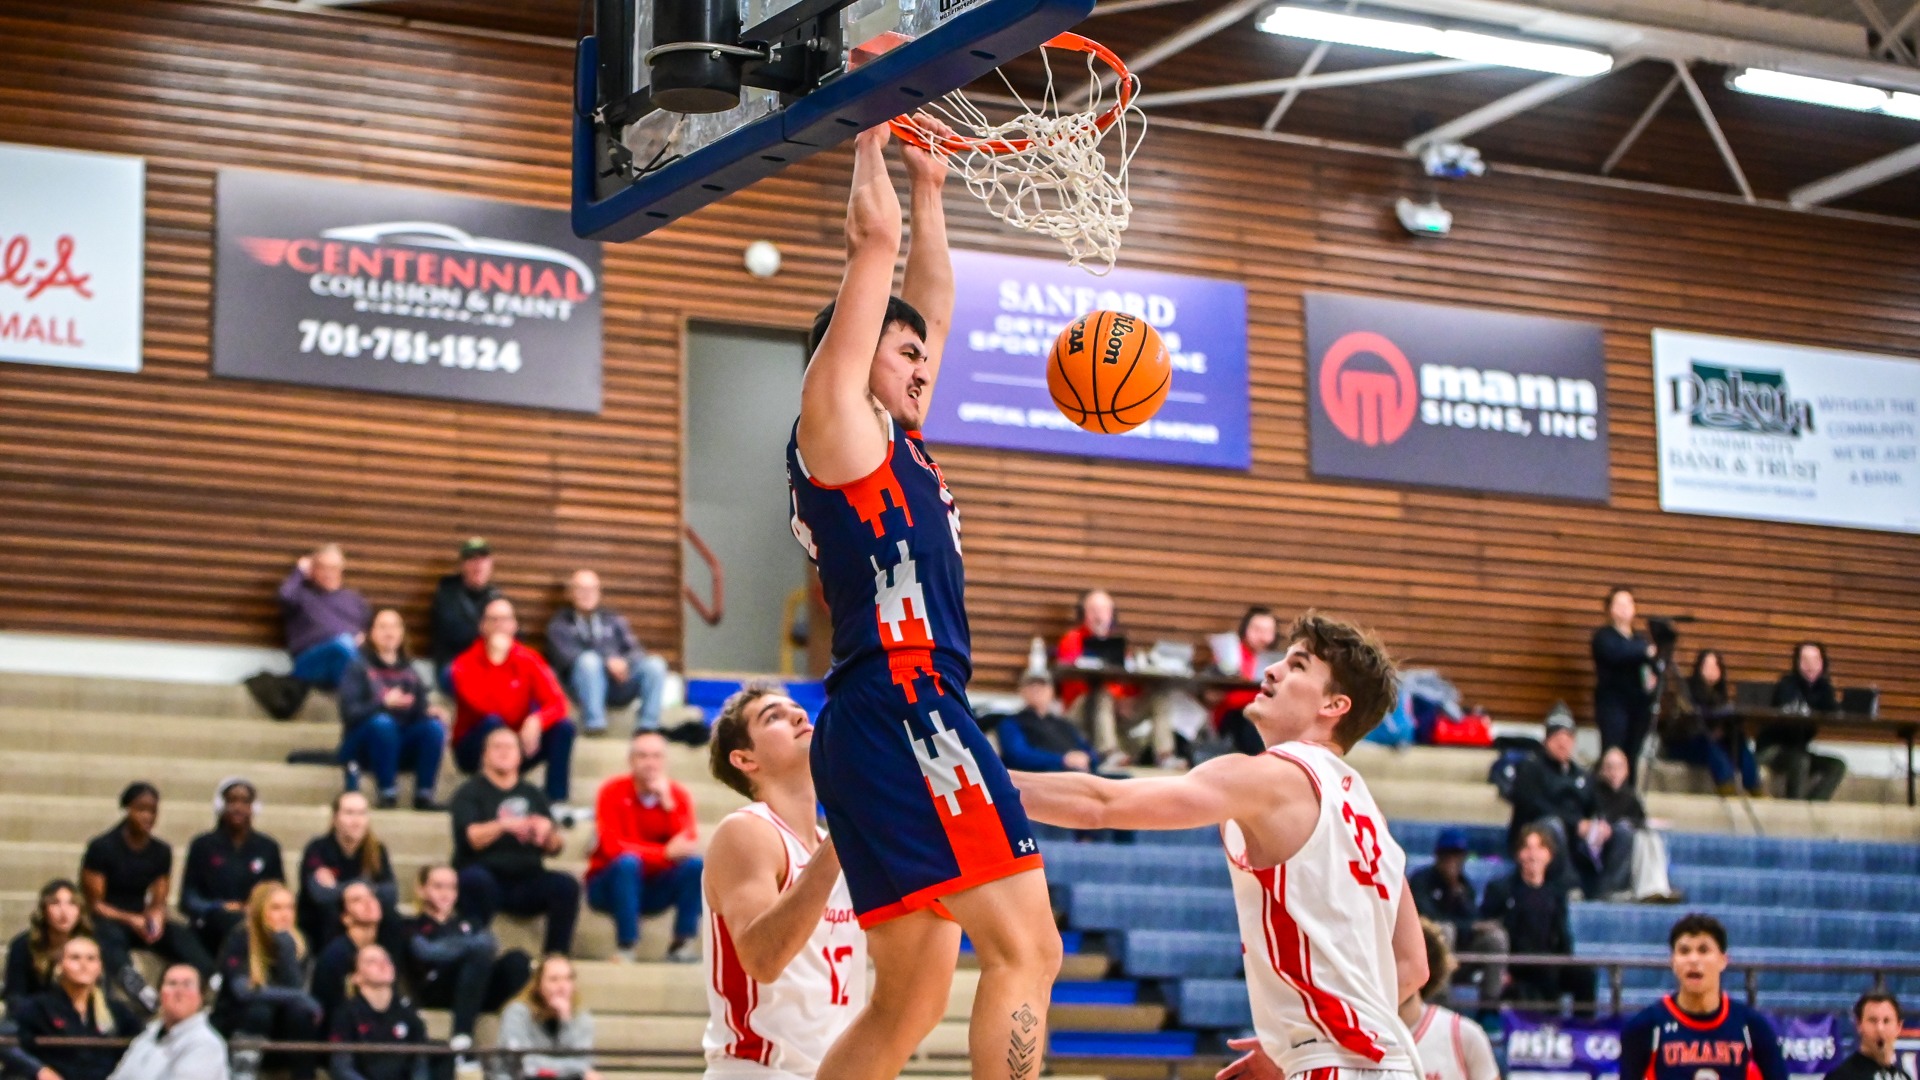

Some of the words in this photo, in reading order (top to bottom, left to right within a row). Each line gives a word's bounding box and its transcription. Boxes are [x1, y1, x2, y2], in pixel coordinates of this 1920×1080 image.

[286, 239, 589, 302] CENTENNIAL
[309, 273, 462, 309] COLLISION
[465, 288, 489, 313] &
[492, 291, 573, 321] PAINT
[998, 279, 1176, 327] SANFORD
[1420, 363, 1598, 415] mann
[1669, 368, 1815, 433] Dakota
[1421, 399, 1532, 437] SIGNS,
[1539, 411, 1598, 441] INC
[822, 945, 853, 1006] 12
[1663, 1040, 1744, 1066] UMARY
